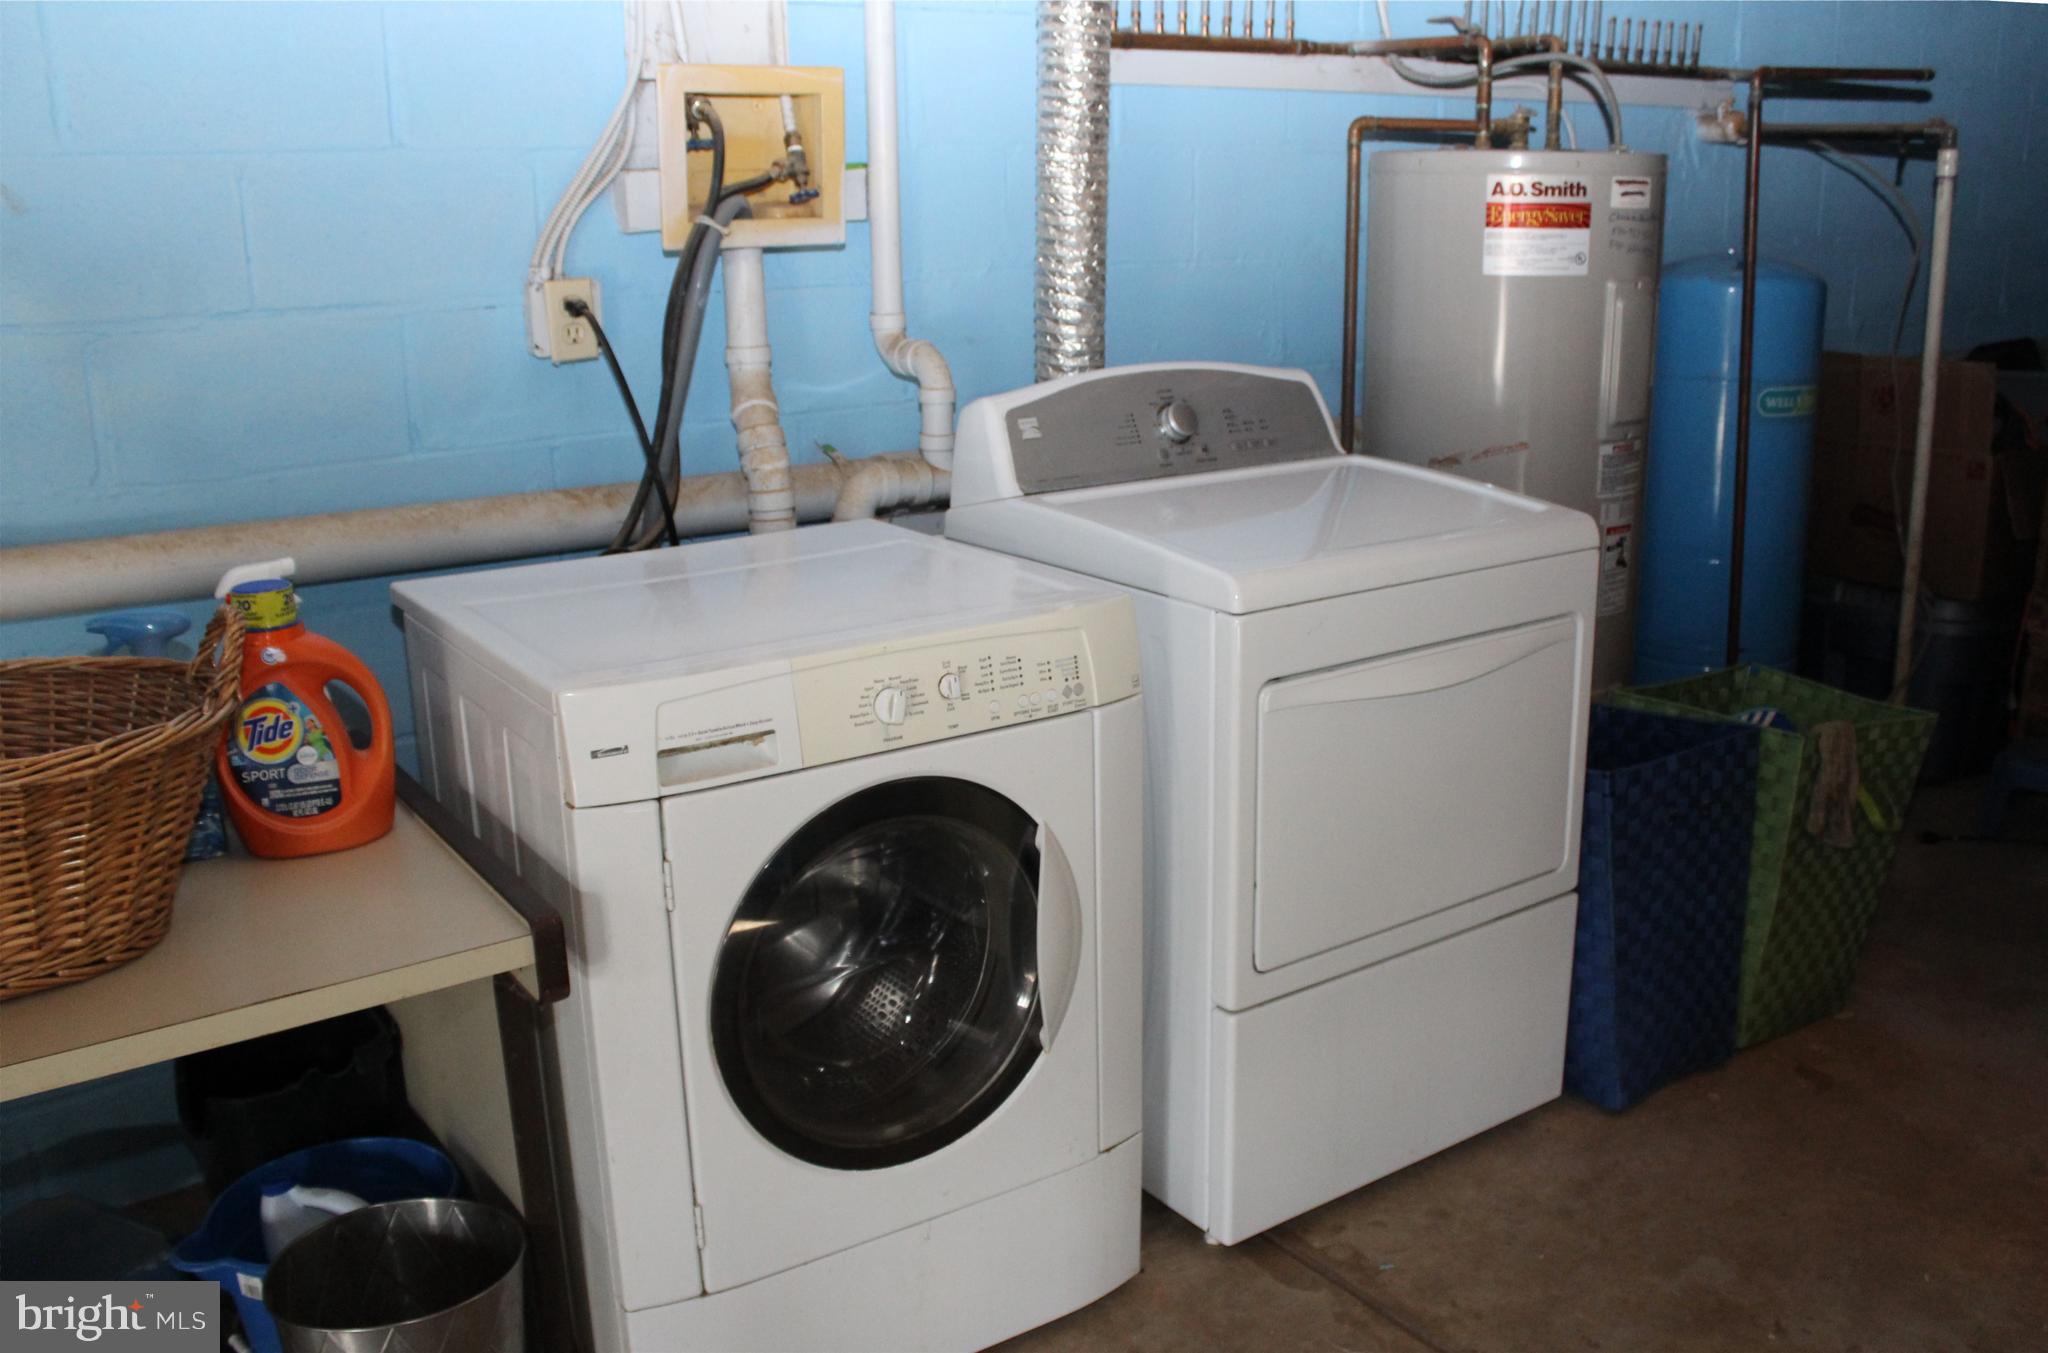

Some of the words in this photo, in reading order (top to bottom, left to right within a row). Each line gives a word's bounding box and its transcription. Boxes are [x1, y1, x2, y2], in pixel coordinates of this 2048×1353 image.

[1491, 181, 1527, 197] A.O.
[1531, 180, 1588, 198] Smith
[243, 713, 294, 752] Tide
[241, 767, 287, 783] SPORT
